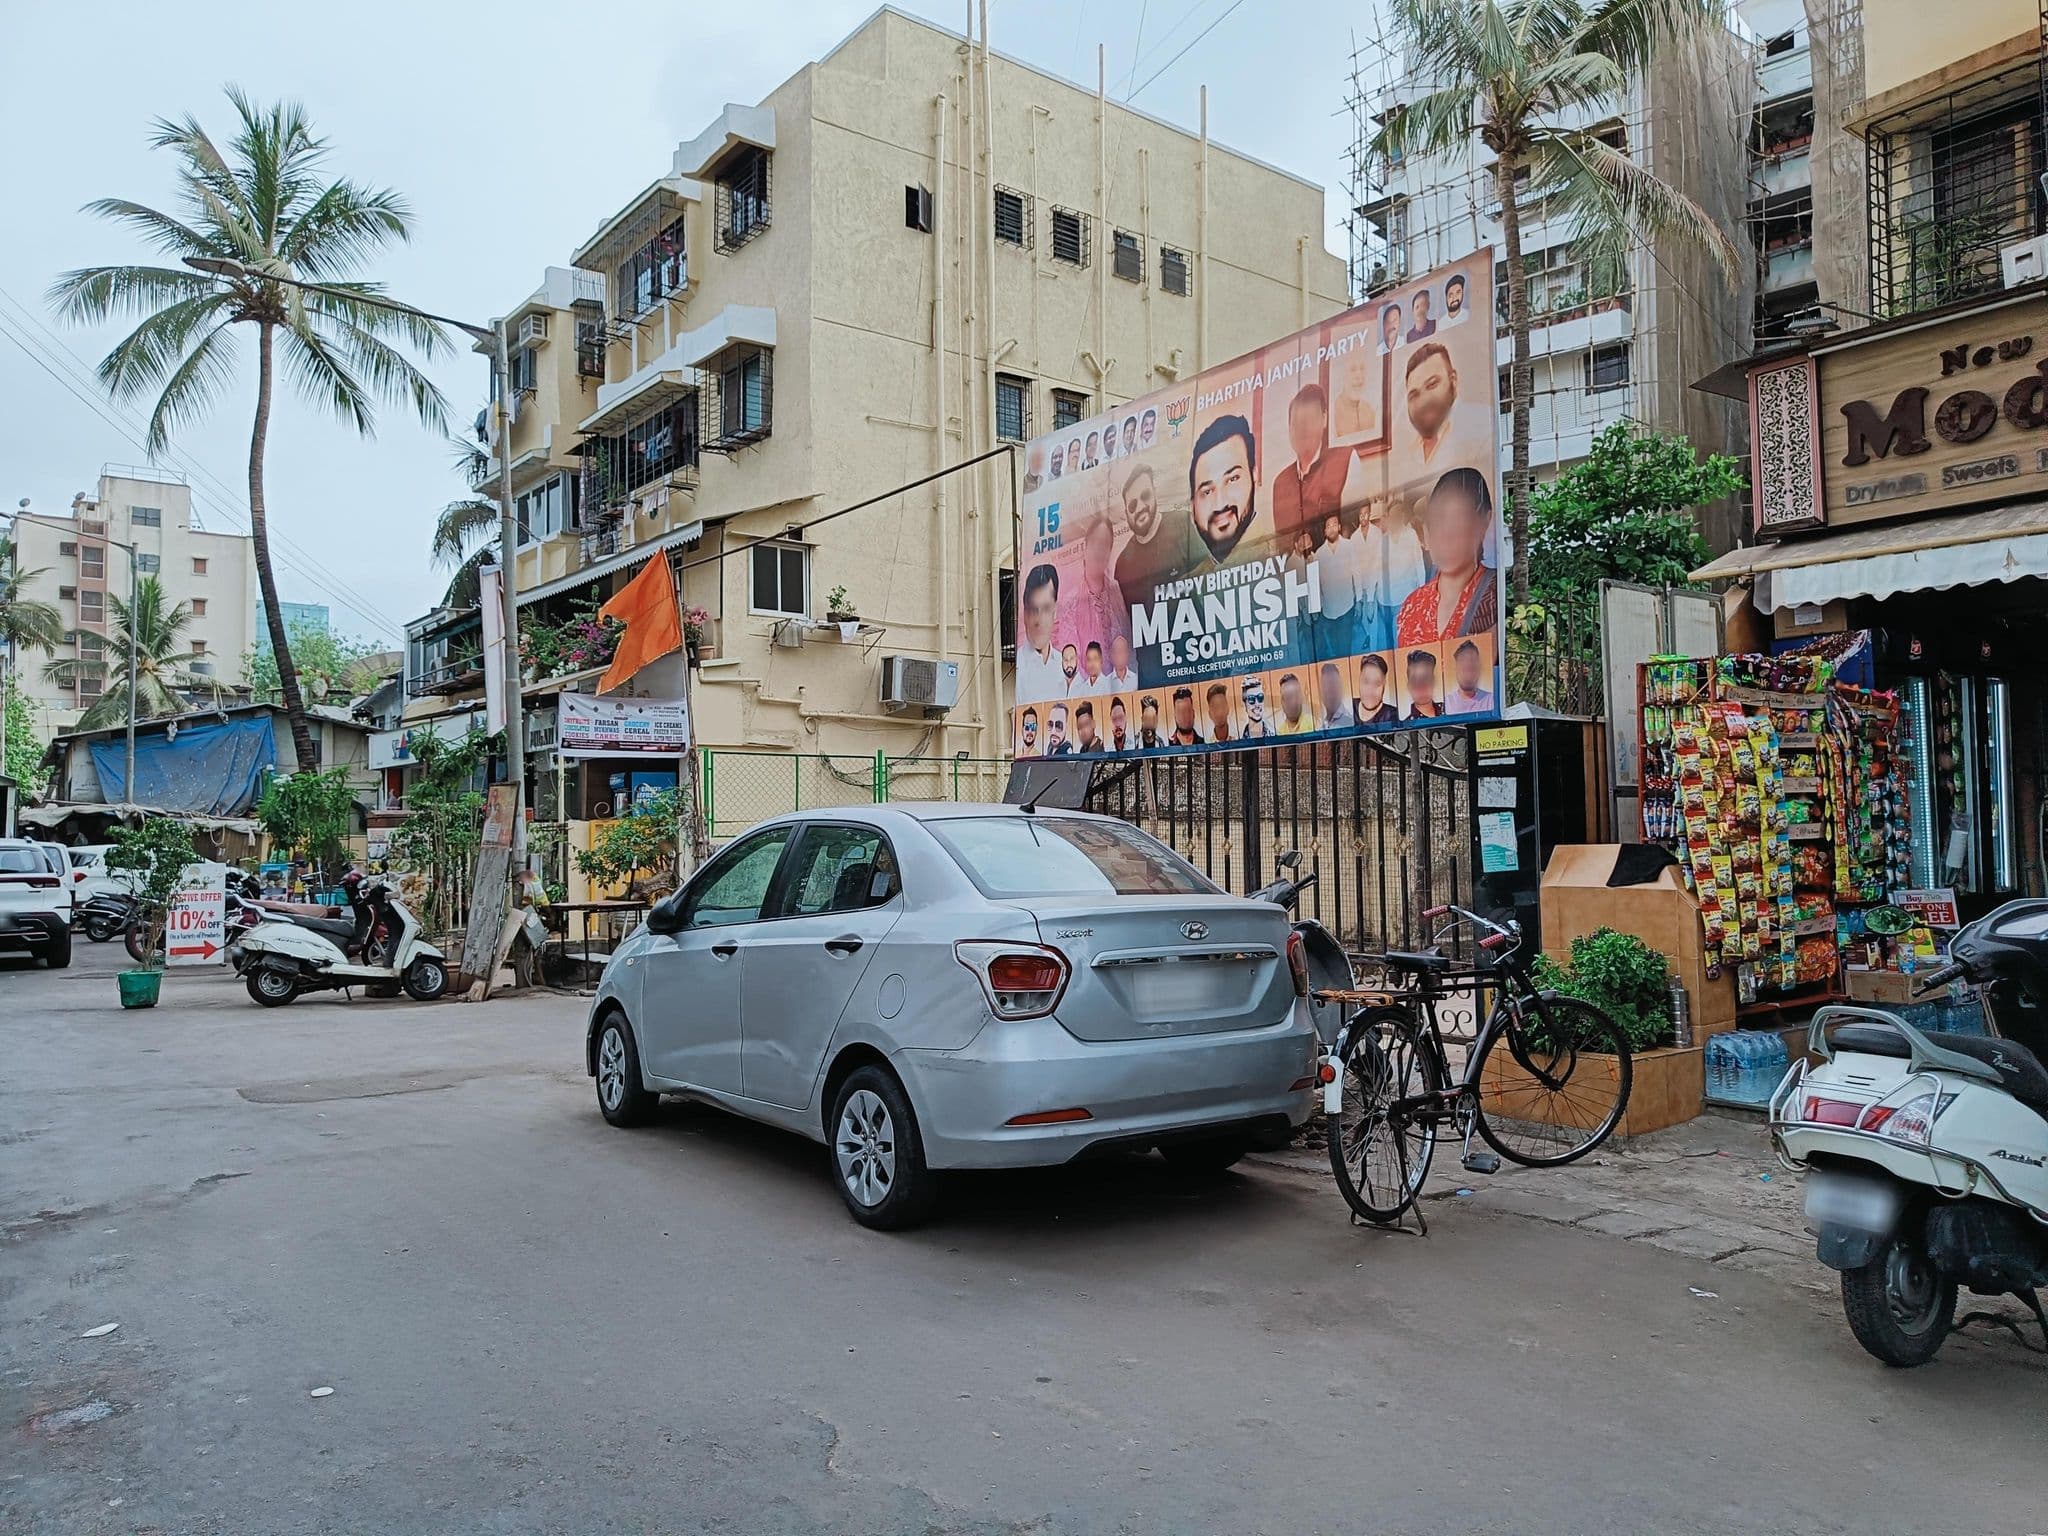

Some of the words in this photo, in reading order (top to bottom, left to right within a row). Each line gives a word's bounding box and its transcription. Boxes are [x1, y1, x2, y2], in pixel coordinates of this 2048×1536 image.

[1196, 373, 1264, 410] BHARTIYA
[1265, 353, 1311, 388] JANTA
[1316, 328, 1369, 364] PARTY
[1940, 336, 2033, 376] New
[1943, 455, 2018, 484] Sweets
[1037, 502, 1060, 537] 15
[1033, 534, 1063, 555] APRIL
[1154, 575, 1204, 601] HAPPY
[1206, 554, 1288, 591] BIRTHDAY
[1131, 560, 1321, 649] MANISH
[1161, 641, 1182, 666] B.
[1186, 620, 1288, 661] SOLANKI
[1167, 664, 1197, 678] GENERAL
[1197, 658, 1237, 674] SECRETORY
[1236, 655, 1259, 667] WARD
[1260, 652, 1272, 663] NO
[1273, 650, 1284, 660] 69
[1480, 741, 1491, 749] NO
[1492, 739, 1524, 747] PARKING
[200, 893, 222, 901] OFFER
[1906, 894, 1922, 902] Buy
[1926, 903, 1949, 911] ONE
[207, 921, 221, 929] OFF
